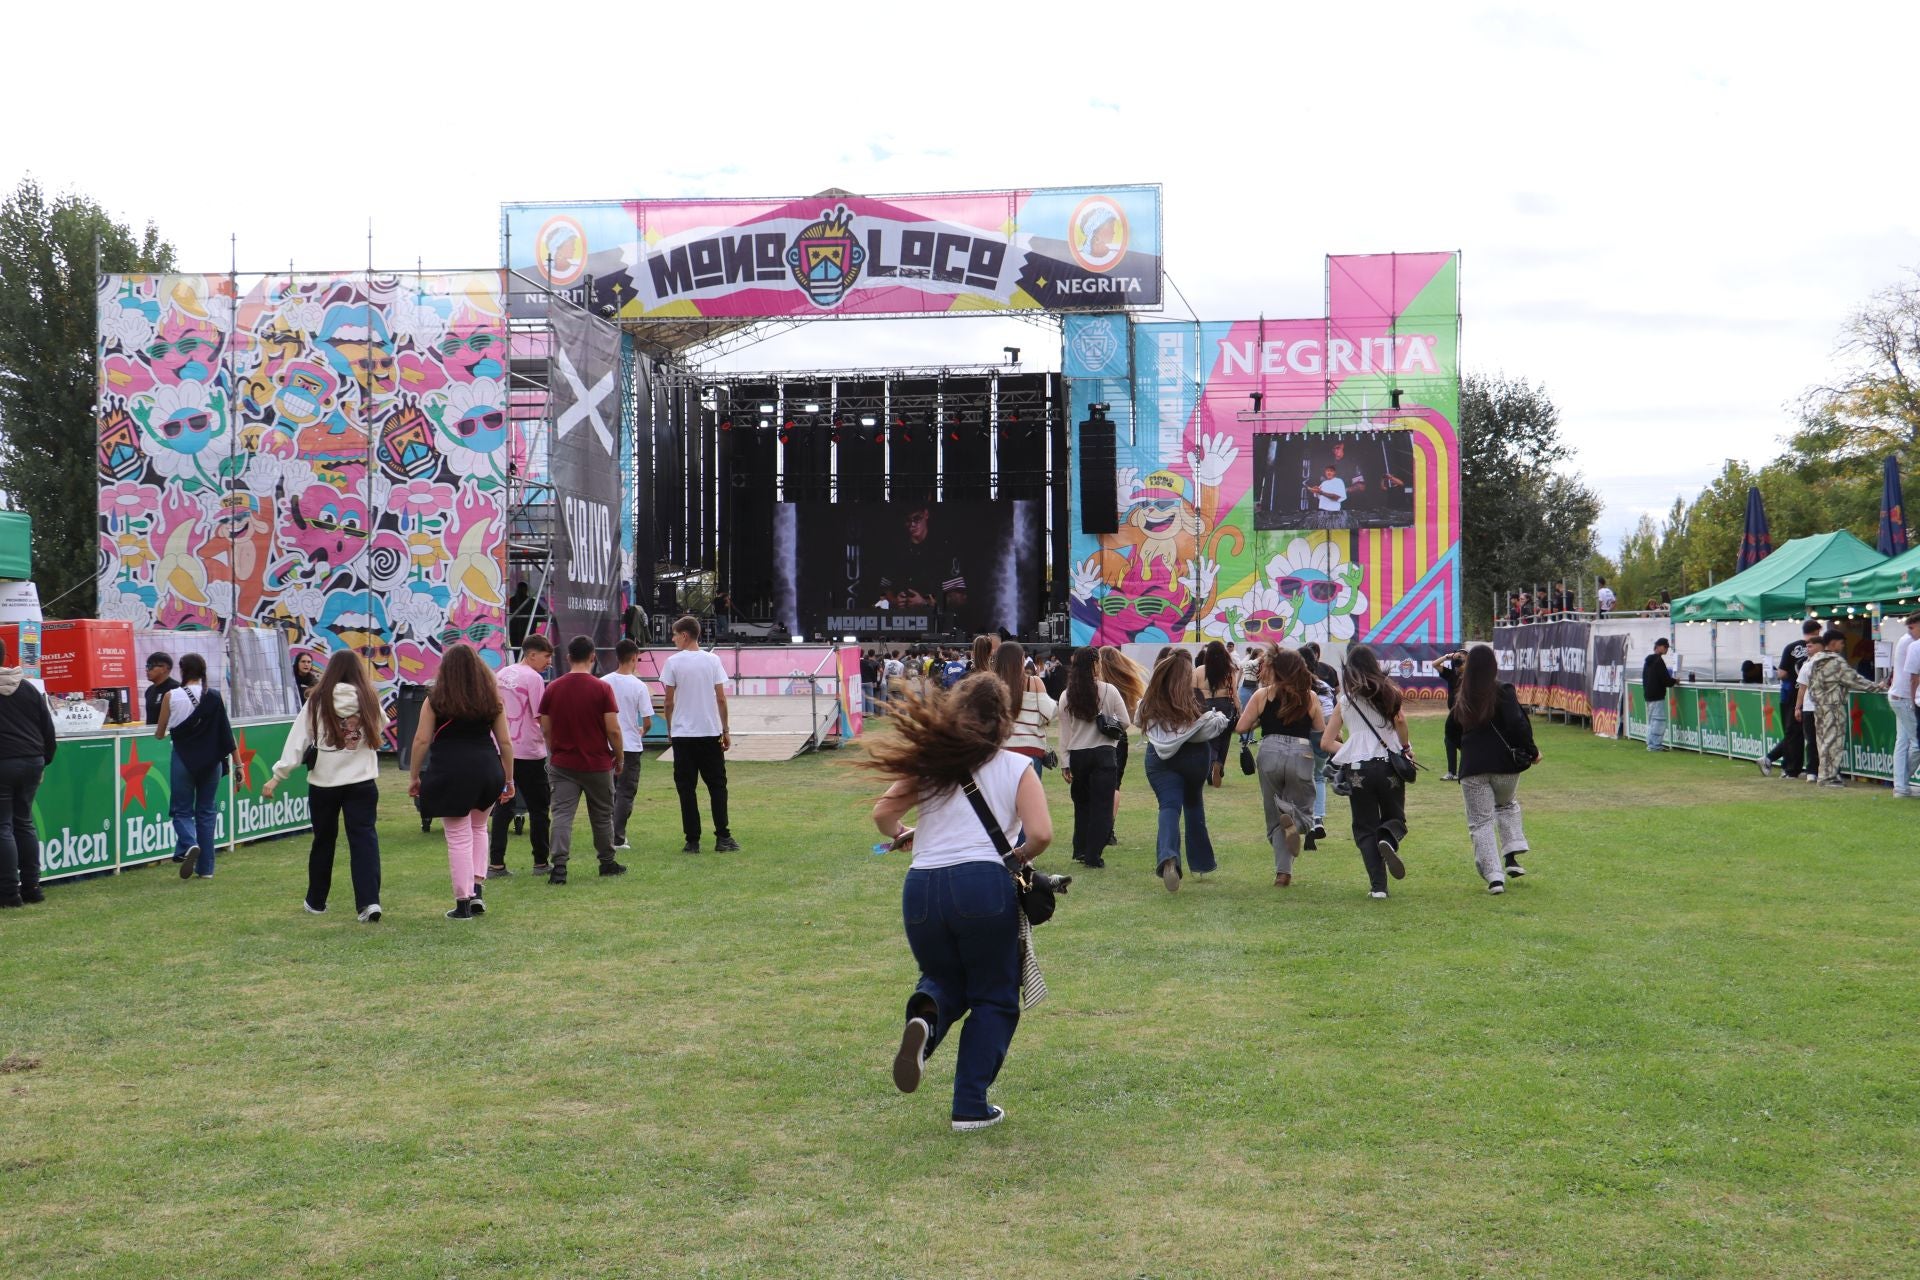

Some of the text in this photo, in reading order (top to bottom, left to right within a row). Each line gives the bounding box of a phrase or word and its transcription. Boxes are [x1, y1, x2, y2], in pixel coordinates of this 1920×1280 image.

[647, 229, 1007, 299] MONO LOCO
[1056, 276, 1137, 294] NEGRITA
[1222, 336, 1434, 375] NEGRITA
[566, 497, 611, 585] SIBUYA
[828, 616, 928, 630] MONO LOCO
[1731, 731, 1763, 756] Heineken
[1853, 744, 1893, 774] Heineke
